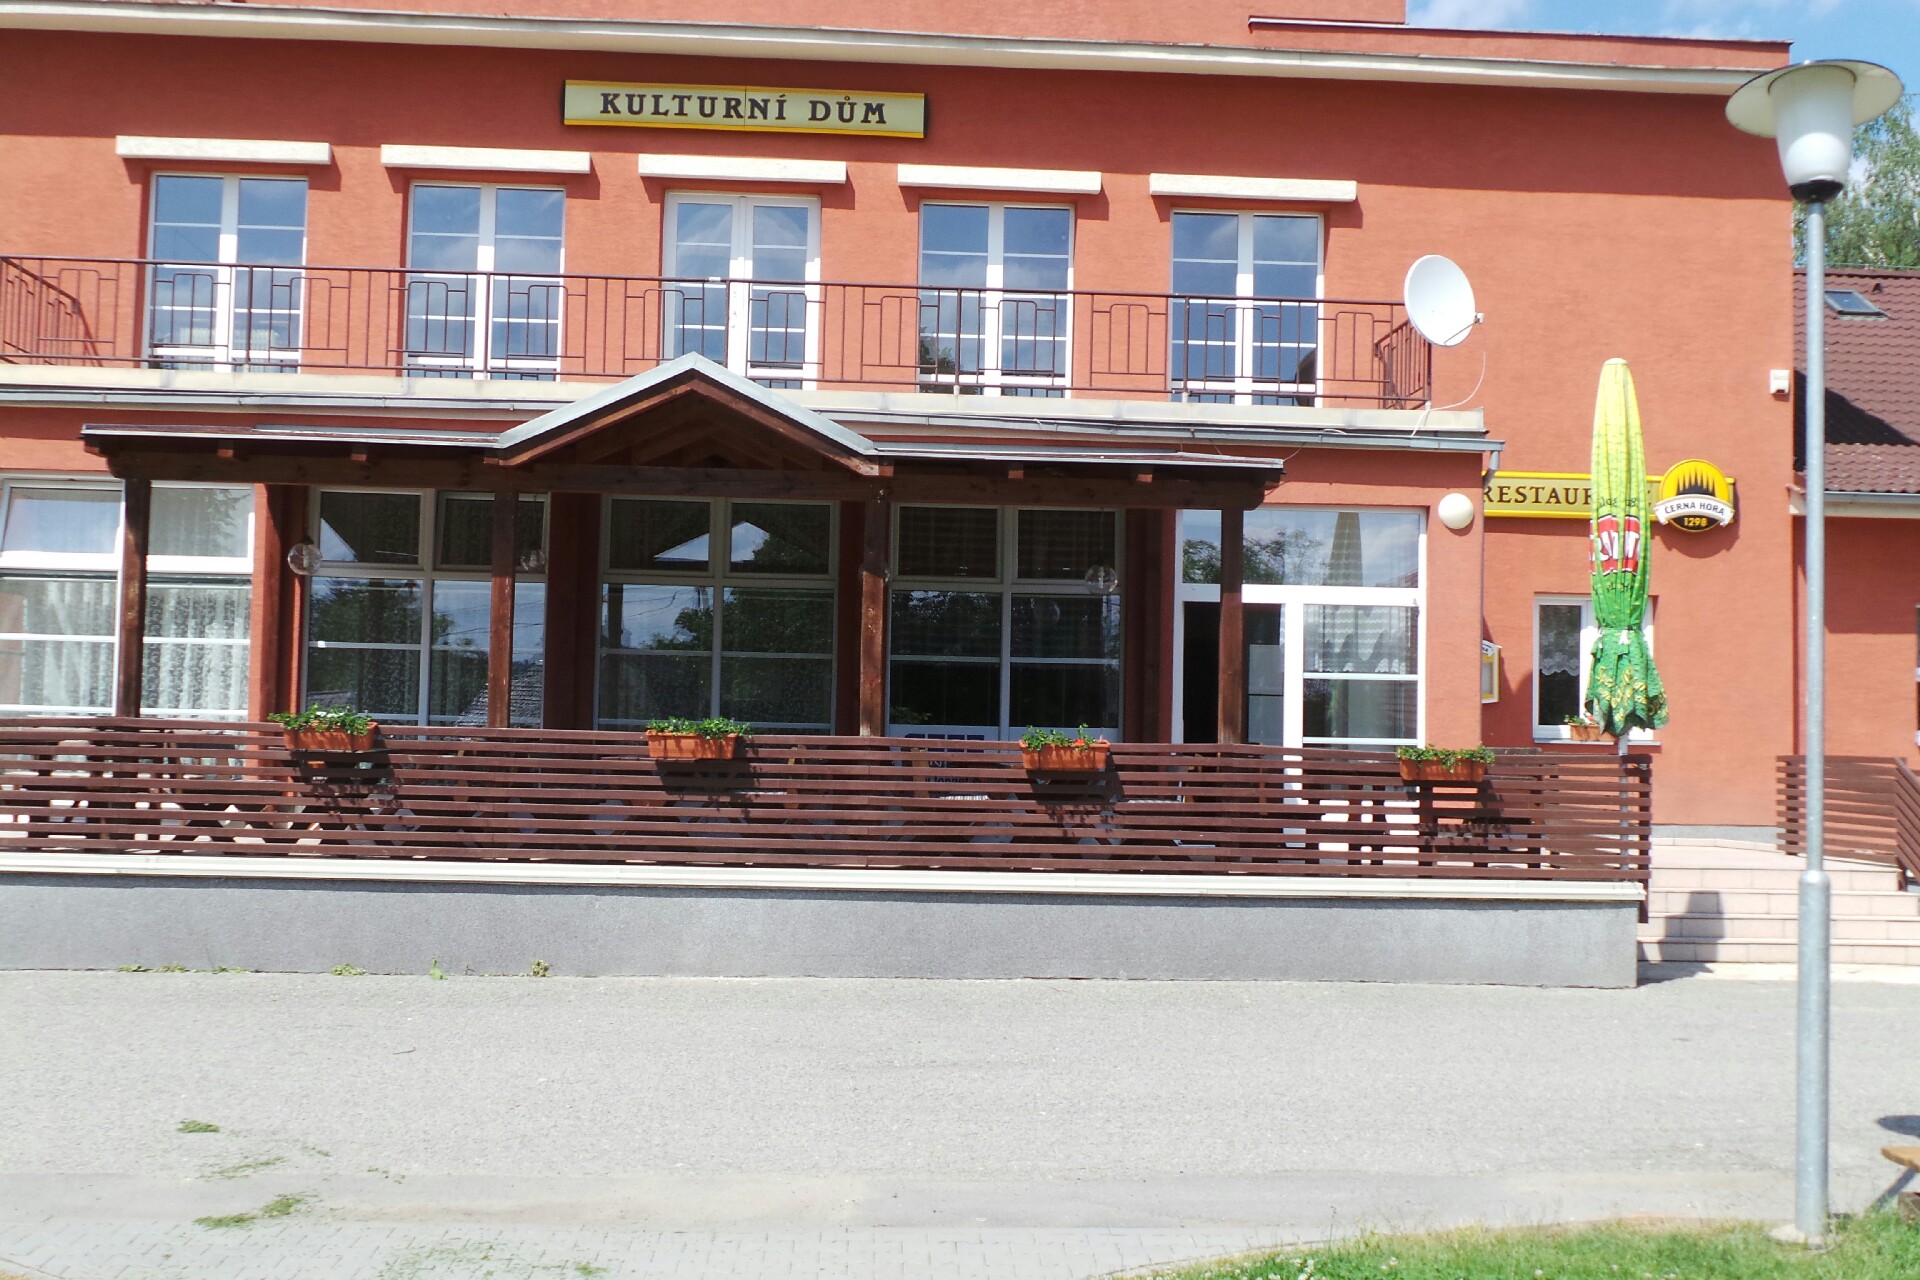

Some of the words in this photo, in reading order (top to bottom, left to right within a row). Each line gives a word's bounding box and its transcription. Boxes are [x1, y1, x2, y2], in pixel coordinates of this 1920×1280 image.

[600, 92, 788, 121] KULTURNÍ
[807, 95, 888, 125] DŮM
[1699, 502, 1725, 517] HORA
[1683, 516, 1708, 527] 1298
